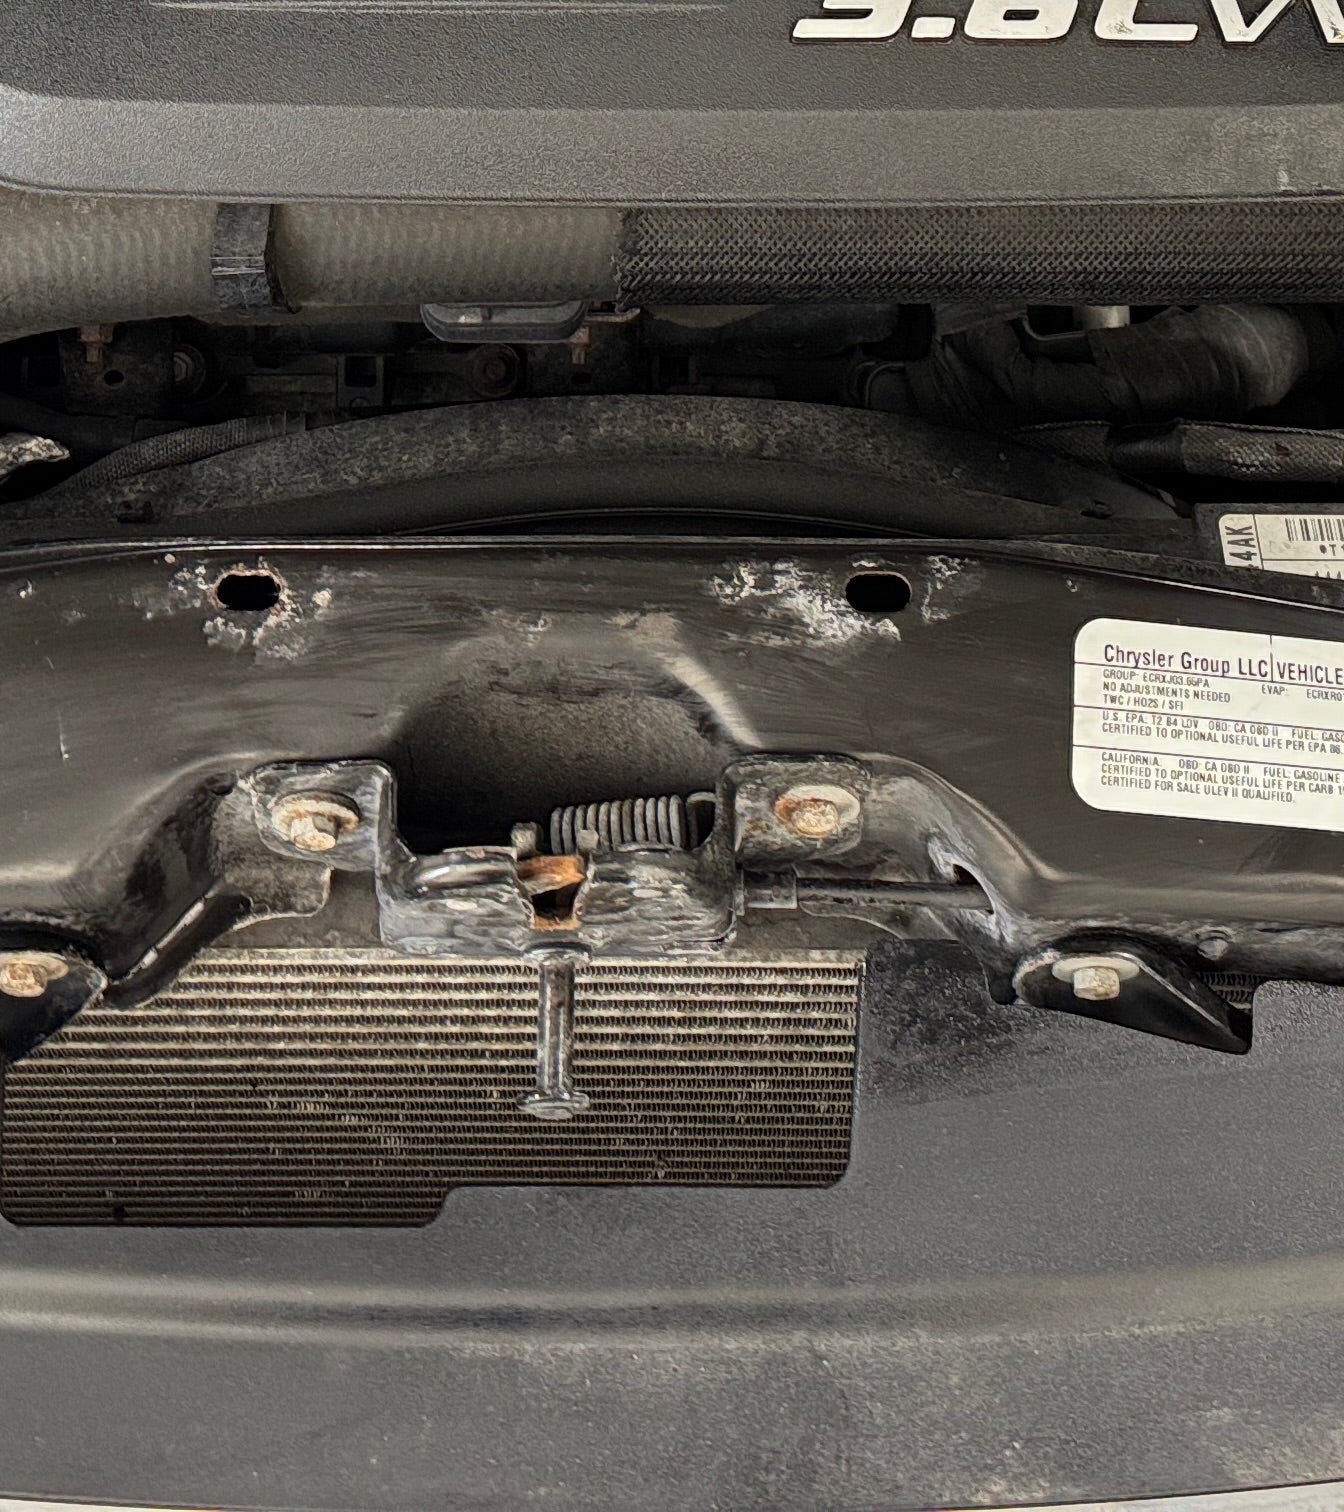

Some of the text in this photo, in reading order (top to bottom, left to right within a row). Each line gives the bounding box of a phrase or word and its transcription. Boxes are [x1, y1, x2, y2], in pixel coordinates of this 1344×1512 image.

[1104, 644, 1268, 677] Chrysler Group LLC
[1276, 661, 1343, 685] VEHICLE
[1102, 693, 1184, 711] TWC HO2S SFI
[1103, 681, 1230, 703] NO ADJUSTMENTS NEEDED
[1261, 684, 1289, 696] EVAP:
[1102, 710, 1122, 721] U.S.
[1151, 715, 1163, 725] T2
[1165, 716, 1178, 727] B4
[1233, 722, 1247, 734] CA
[1249, 724, 1269, 736] OBD
[1102, 721, 1326, 754] CERTIFIED TO OPTIONAL USEFUL LIFE PER EPA
[1101, 763, 1151, 778] CERTIFIED
[1154, 768, 1167, 779] TO
[1170, 769, 1218, 784] OPTIONAL
[1221, 774, 1260, 788] USEFUL
[1262, 778, 1283, 790] LIFE
[1285, 780, 1306, 792] PER
[1308, 782, 1333, 795] CARB
[1204, 760, 1218, 772] CA
[1220, 762, 1240, 774] OBD
[1293, 769, 1341, 784] GASOLINE
[1101, 774, 1295, 804] CERTIFIED FOR SALE ULEV II QUALIFIED.
